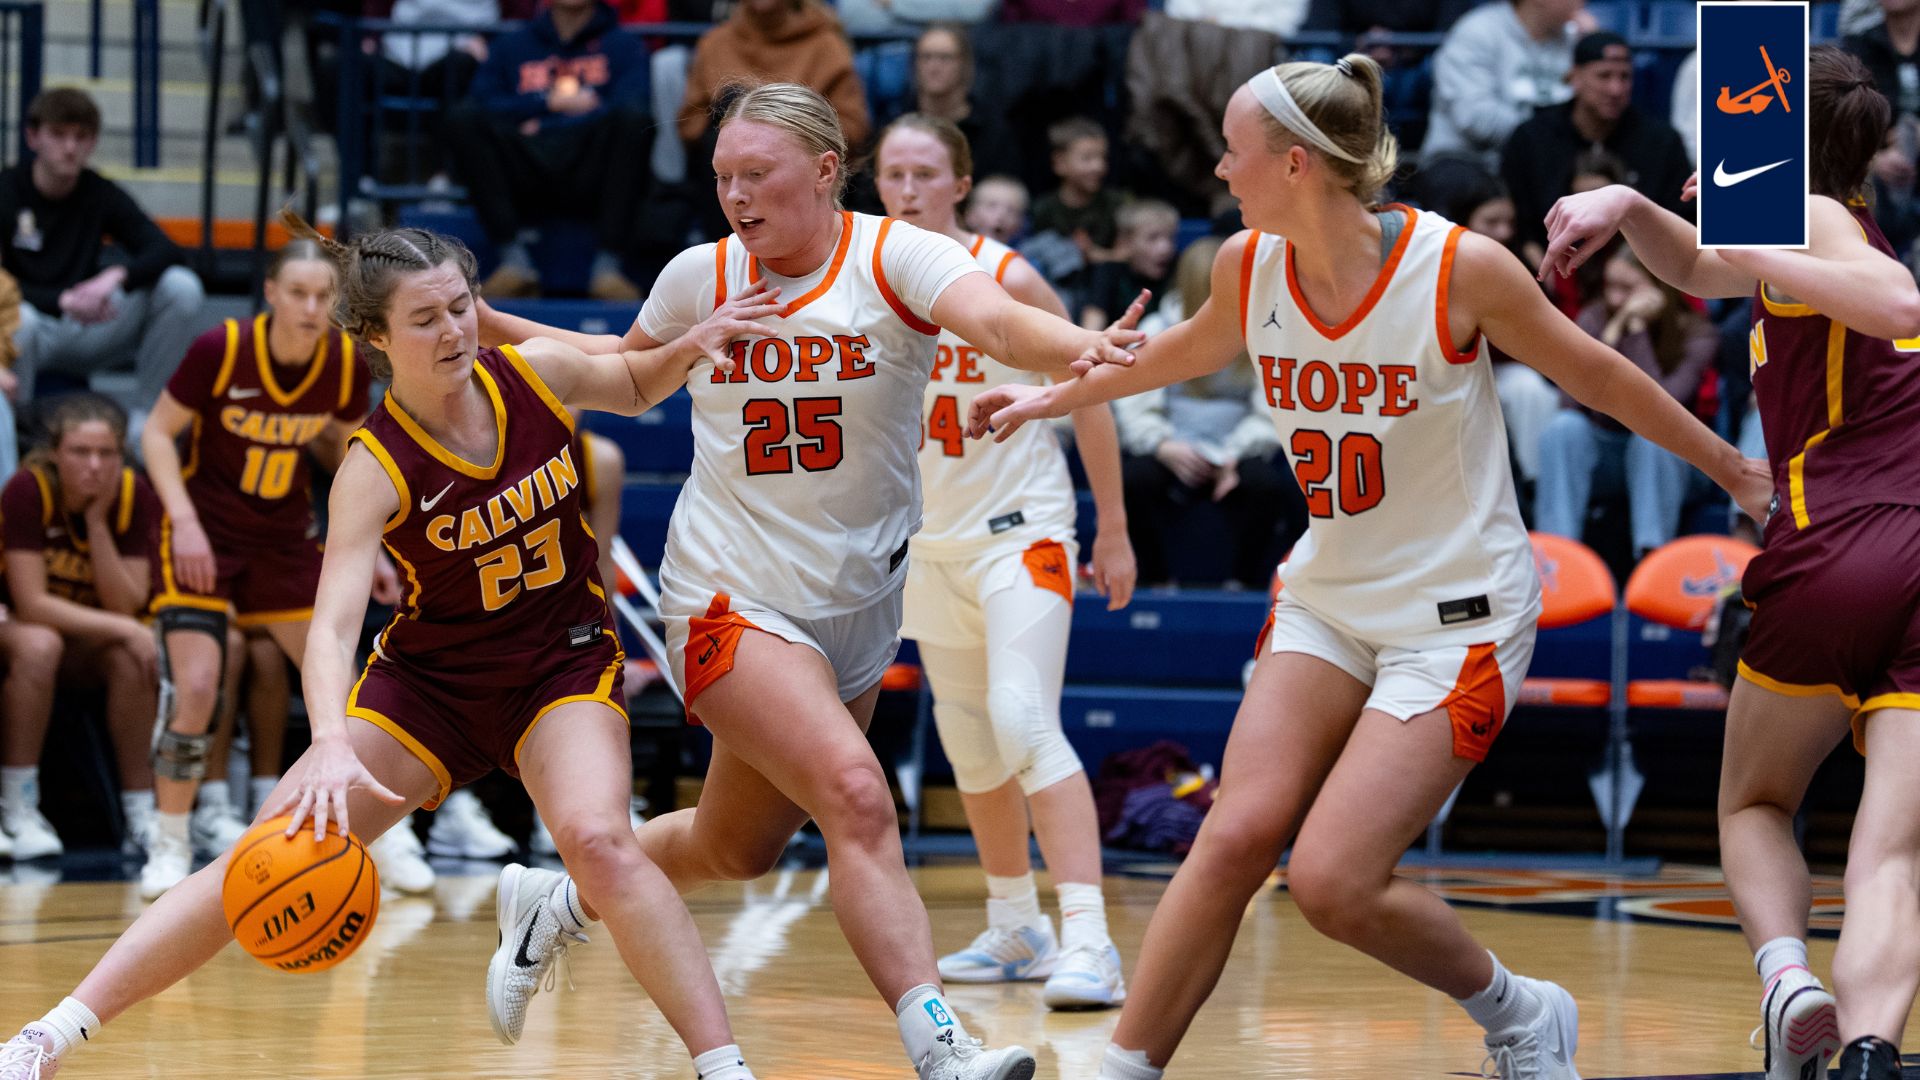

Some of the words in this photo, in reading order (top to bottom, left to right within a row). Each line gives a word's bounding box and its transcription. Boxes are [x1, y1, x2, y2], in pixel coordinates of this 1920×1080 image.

[930, 344, 985, 383] PE
[1258, 355, 1419, 417] HOPE
[742, 396, 844, 476] 25
[918, 394, 964, 458] 4
[239, 446, 299, 499] 10
[426, 443, 579, 551] CALVIN
[1290, 428, 1386, 519] 20
[474, 518, 566, 611] 23
